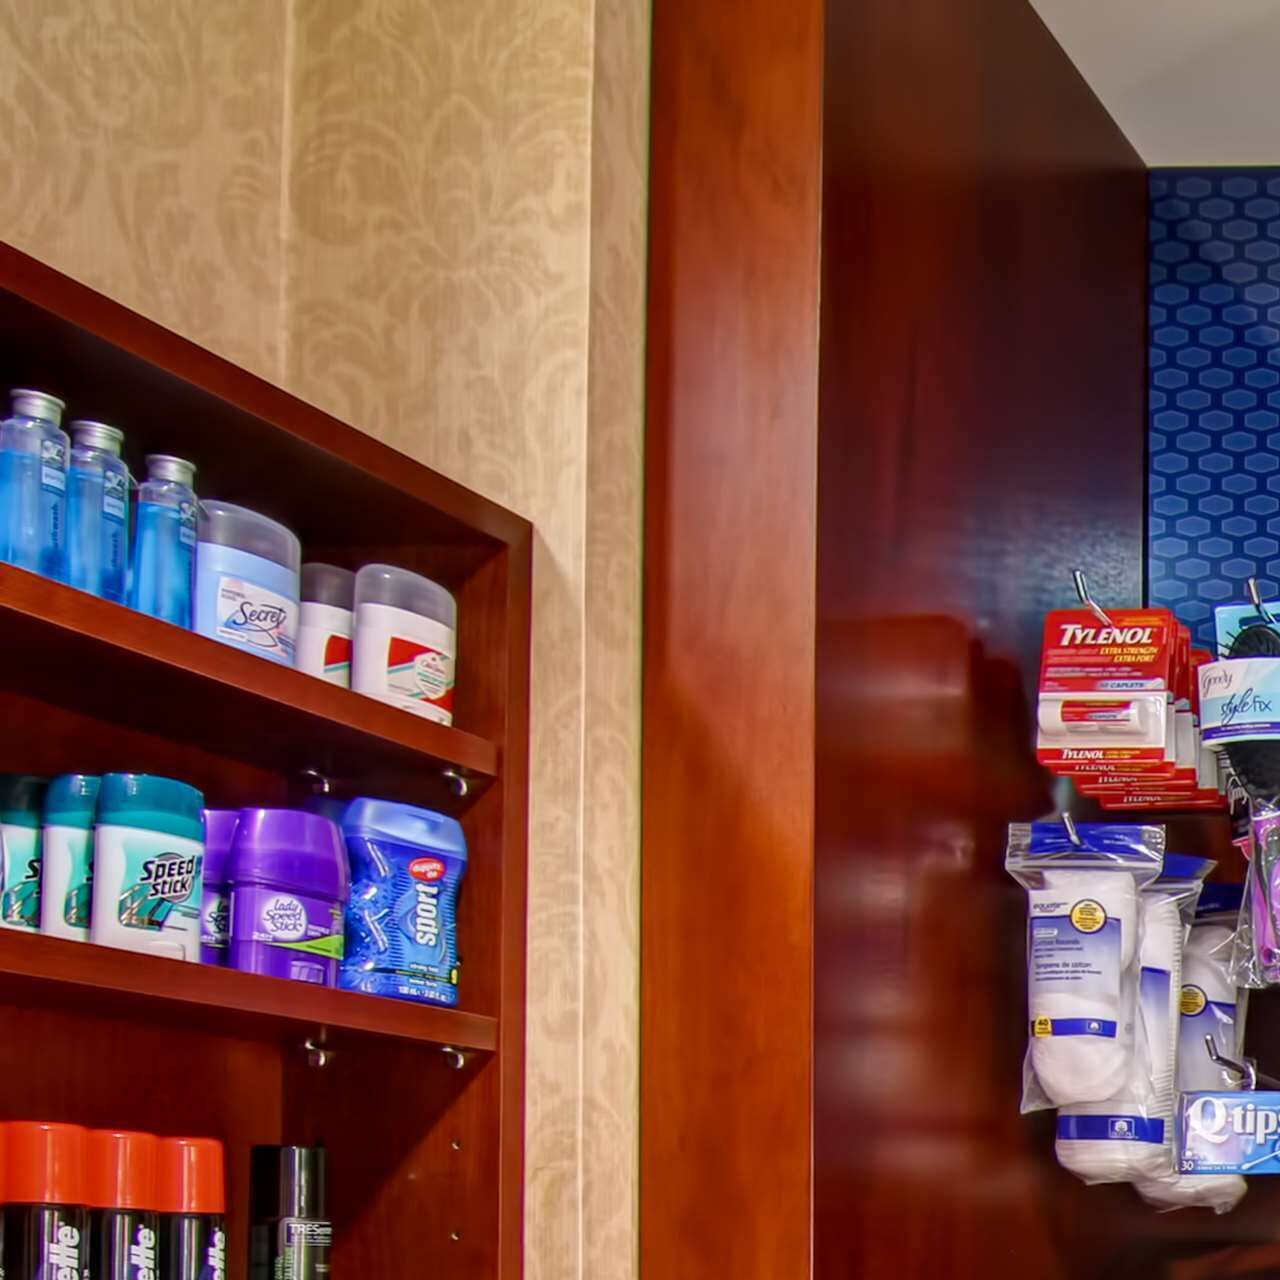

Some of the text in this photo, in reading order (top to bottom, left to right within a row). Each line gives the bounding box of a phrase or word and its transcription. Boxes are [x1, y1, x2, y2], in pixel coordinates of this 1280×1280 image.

[232, 600, 287, 627] Secret
[1059, 624, 1154, 646] TYLENOL
[415, 883, 440, 947] sport
[1181, 1160, 1194, 1171] 30
